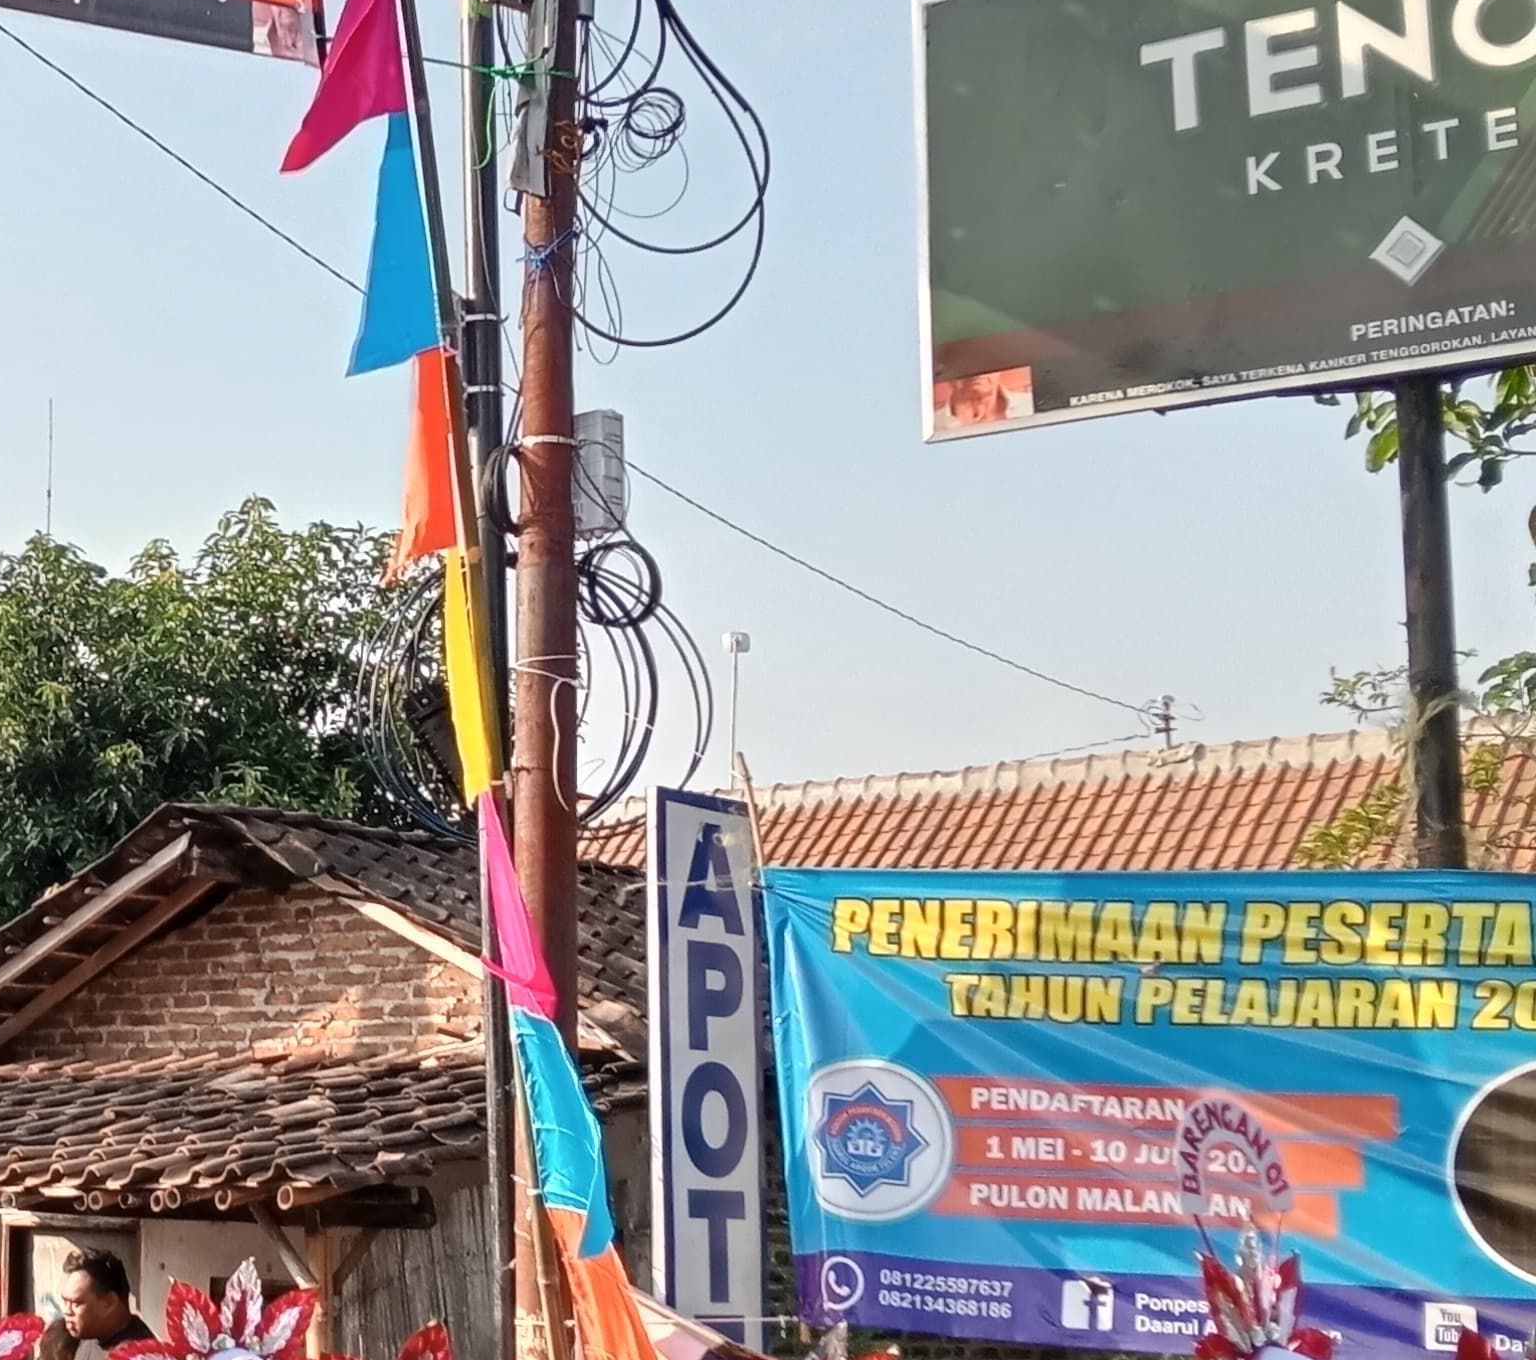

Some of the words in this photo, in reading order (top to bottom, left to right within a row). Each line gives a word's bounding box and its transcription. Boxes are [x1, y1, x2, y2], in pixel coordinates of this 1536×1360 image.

[1351, 299, 1516, 342] PERINGATAN:
[1070, 388, 1125, 407] KARENA
[1126, 377, 1201, 398] MEROKOK,
[1201, 371, 1236, 388] SAYA
[1238, 363, 1307, 382] TERKENA
[1308, 353, 1366, 372] KANKER
[1370, 334, 1487, 364] TENGGOROKAN.
[831, 897, 1227, 966] PENERIMAAN
[1238, 900, 1534, 967] PESERTA
[944, 974, 1125, 1025] TAHUN
[1134, 977, 1462, 1030] PELAJARAN
[677, 823, 747, 1345] APOT
[970, 1087, 1184, 1121] PENDAFTARAN
[985, 1136, 1004, 1159] 1
[1011, 1137, 1064, 1162] MEI
[1090, 1141, 1126, 1163] 10
[970, 1183, 1067, 1210] PULON
[1077, 1187, 1252, 1220] MALANAN
[879, 1268, 1013, 1297] 081225597637
[1135, 1292, 1209, 1316] Ponpes
[1439, 1308, 1462, 1323] You
[1135, 1314, 1199, 1336] Daarul
